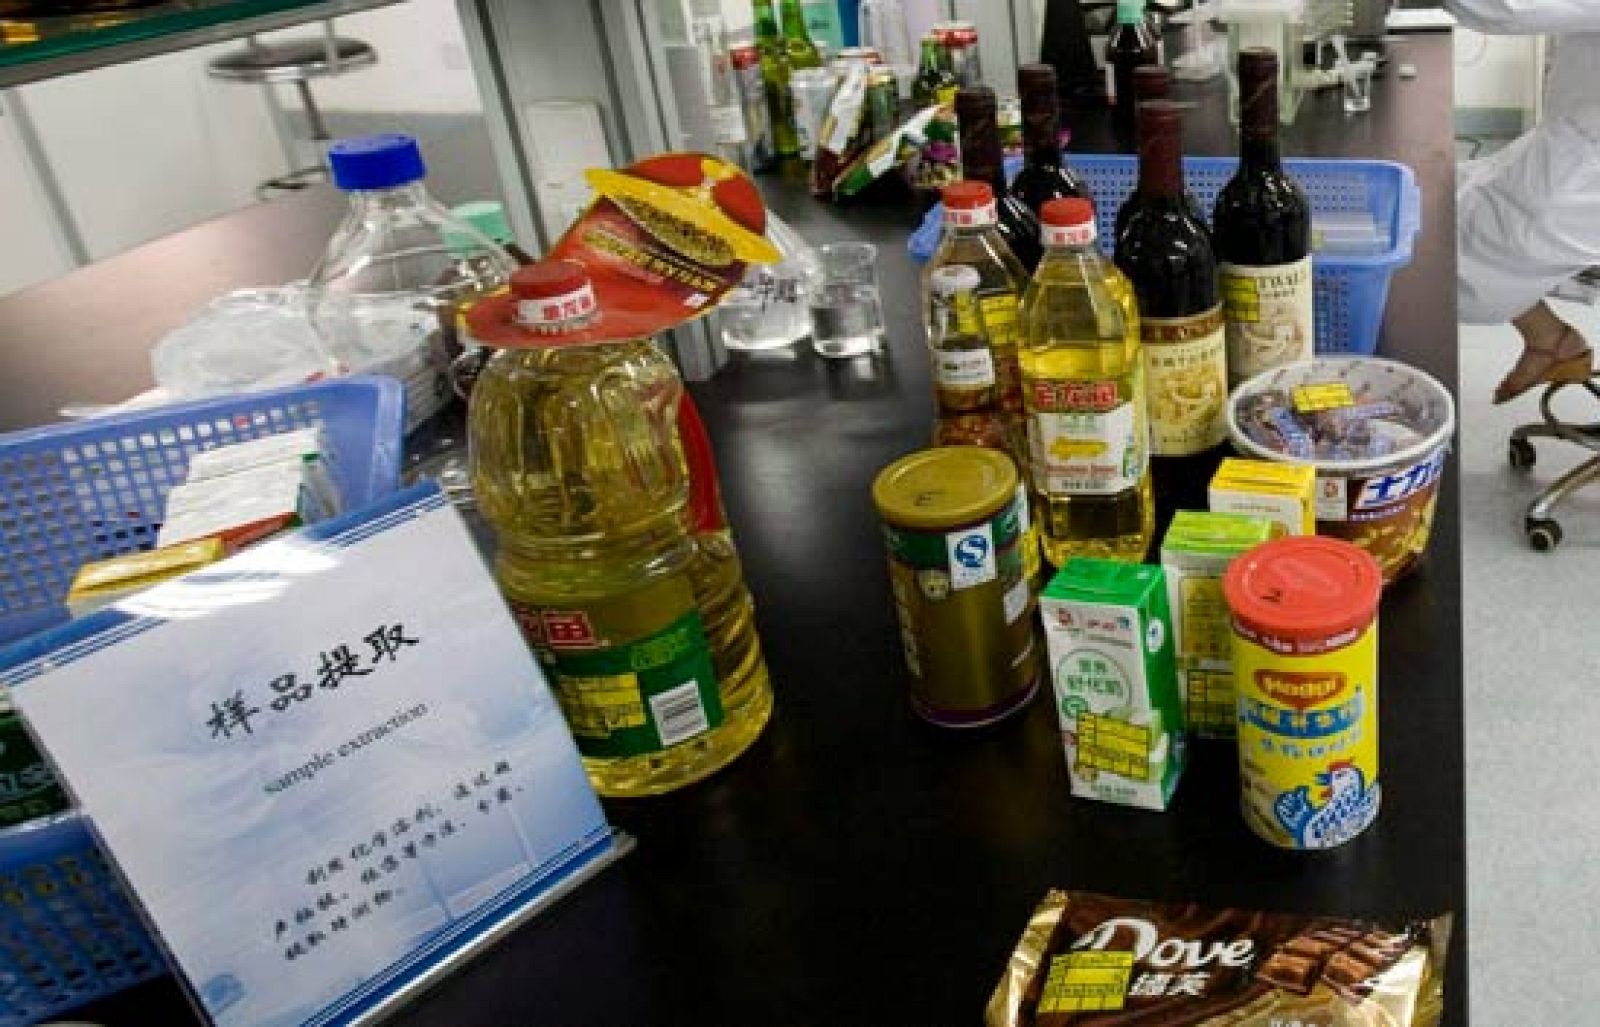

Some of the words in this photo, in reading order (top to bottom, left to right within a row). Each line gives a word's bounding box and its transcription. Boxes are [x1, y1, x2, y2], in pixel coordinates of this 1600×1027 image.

[206, 622, 420, 739] 样品提取
[263, 751, 336, 793] sample
[336, 702, 429, 758] extraction
[1070, 917, 1255, 968] Dove
